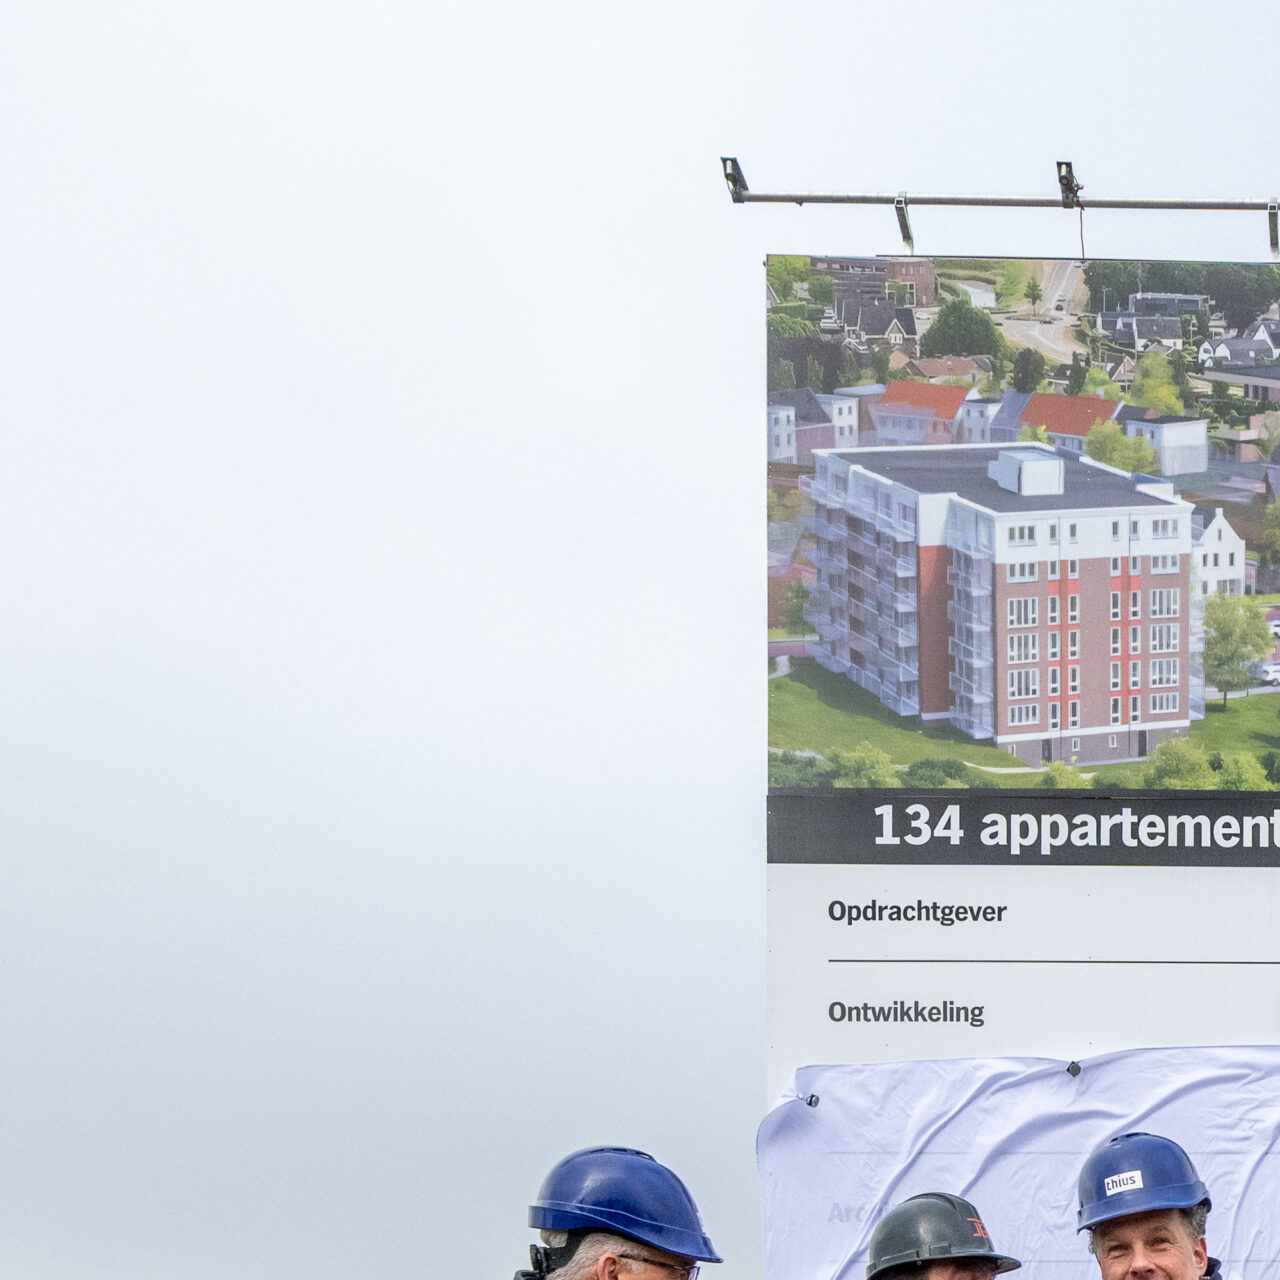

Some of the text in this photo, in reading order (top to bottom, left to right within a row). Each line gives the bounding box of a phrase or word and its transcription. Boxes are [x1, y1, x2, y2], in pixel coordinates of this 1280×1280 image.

[874, 803, 965, 846] 134
[828, 899, 1008, 927] Opdrachtgever
[828, 1000, 985, 1028] Ontwikkeling
[1106, 1175, 1136, 1191] thius
